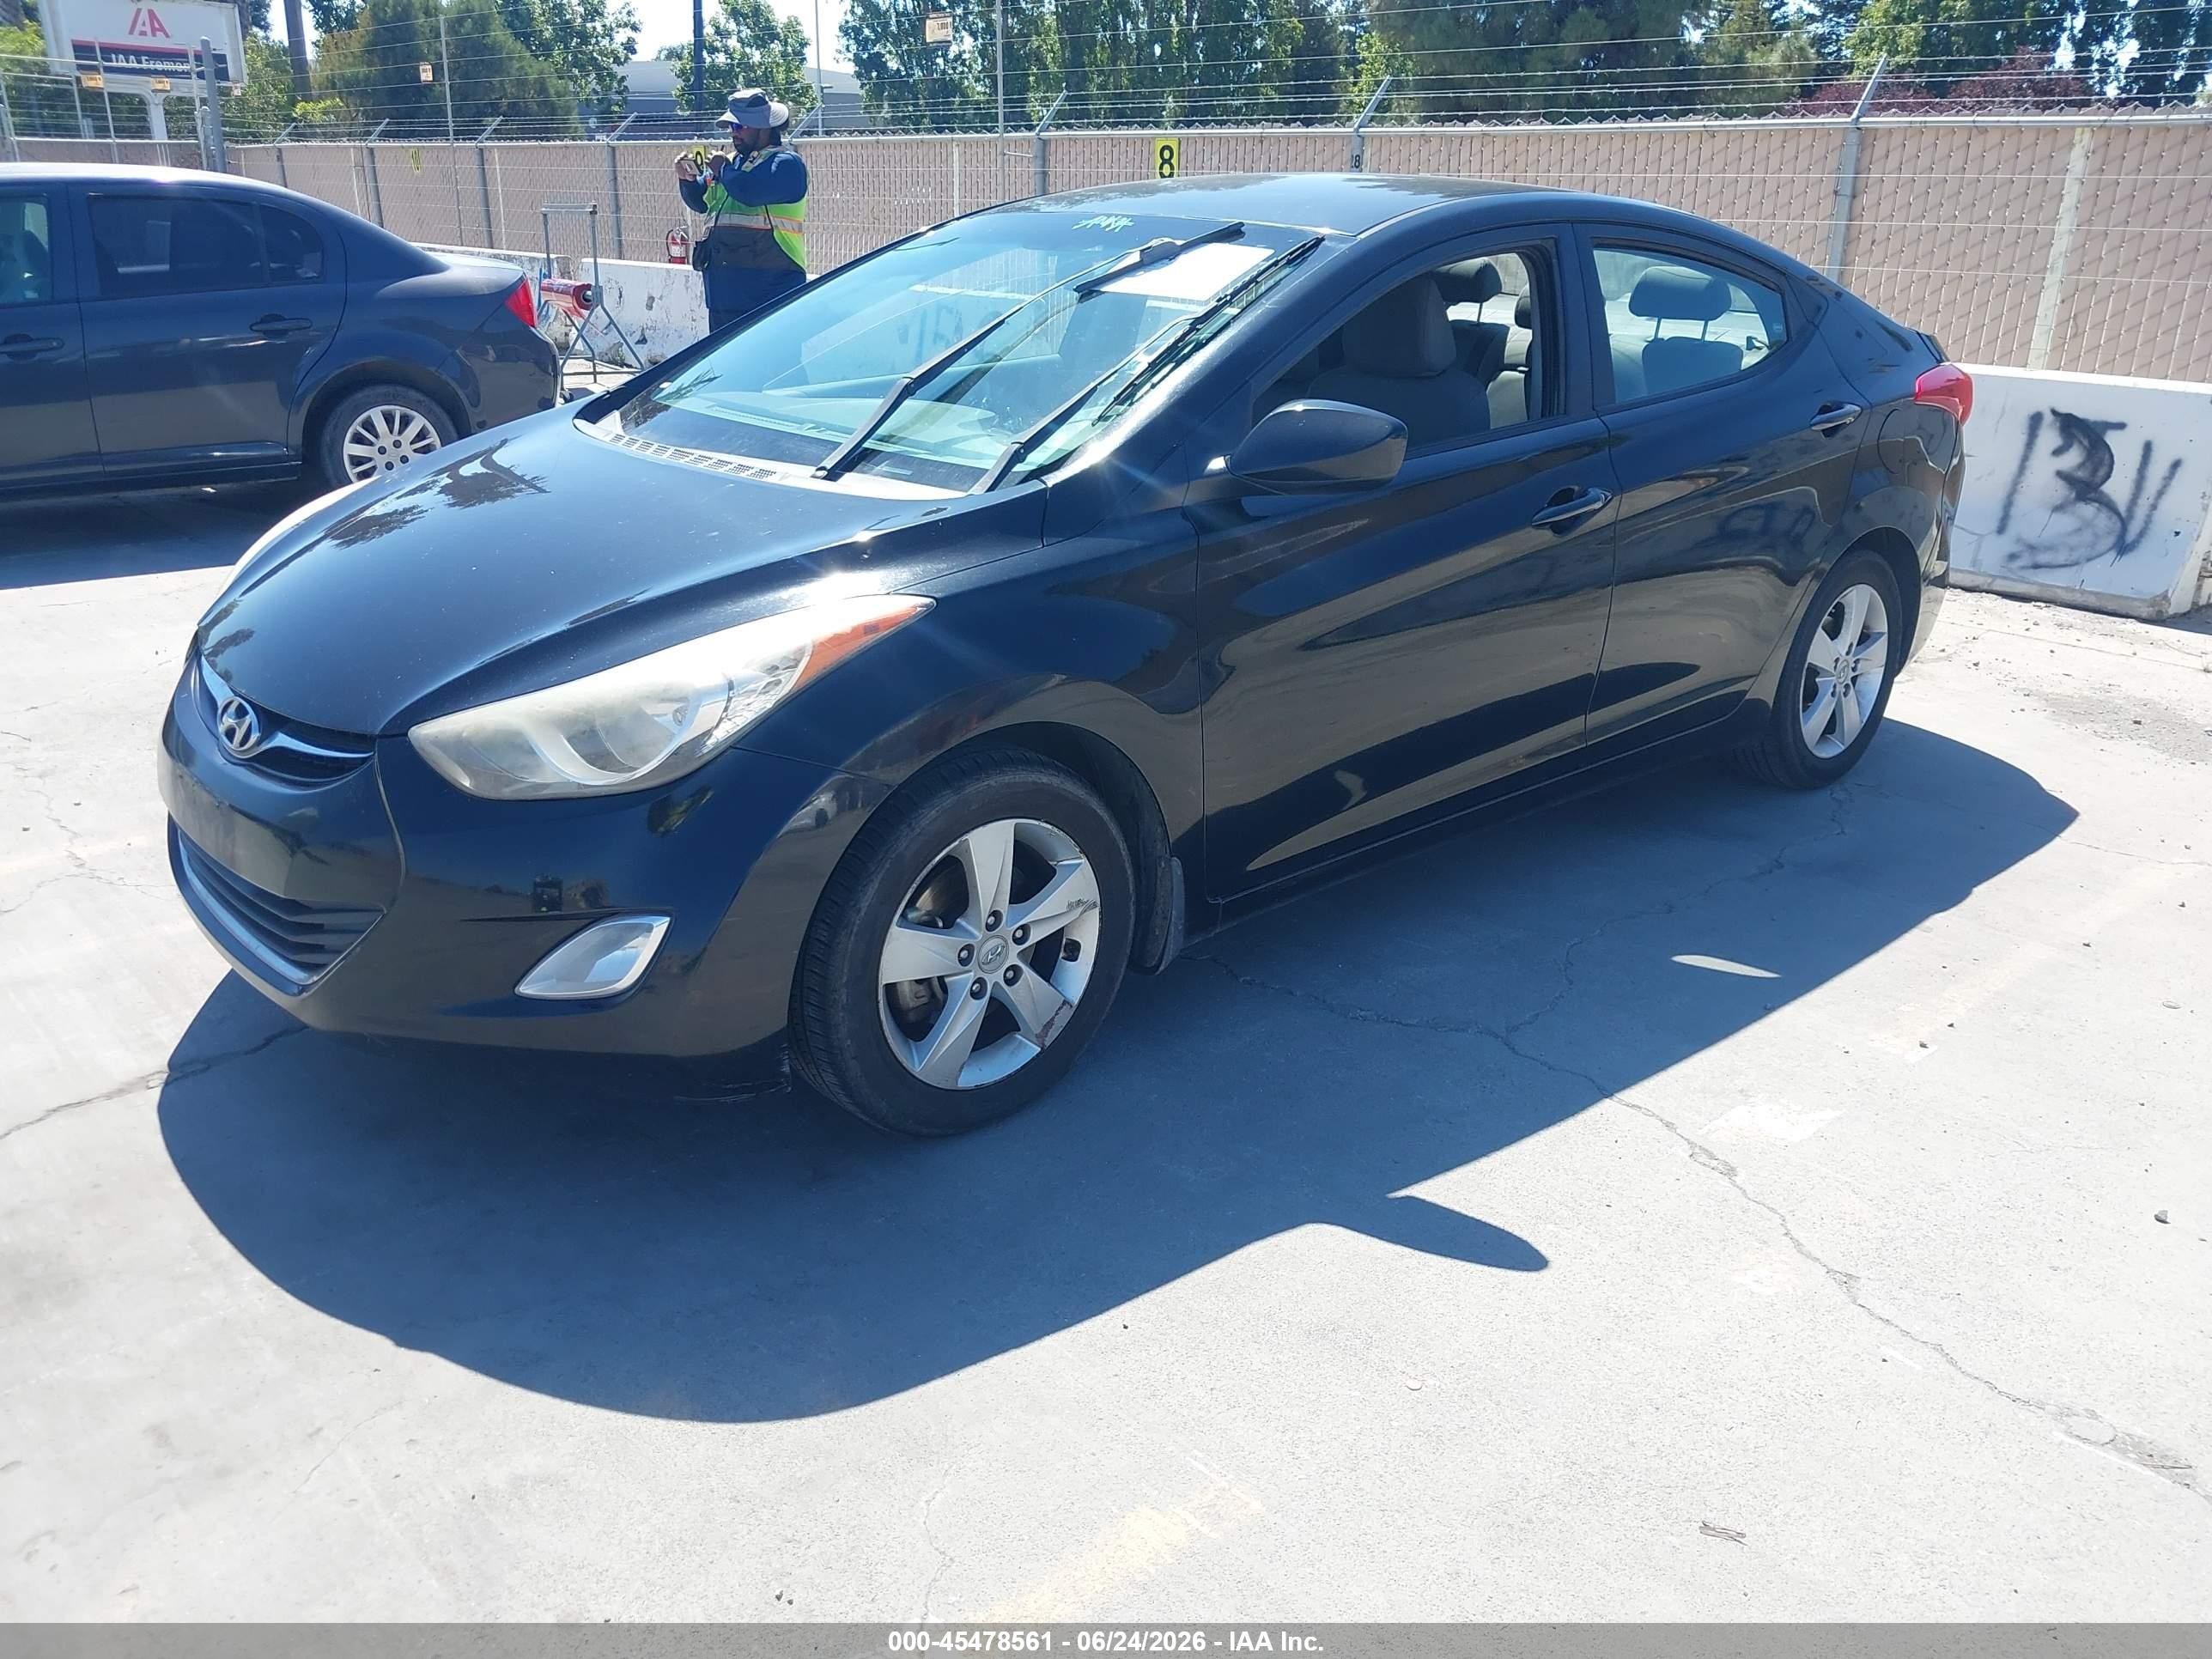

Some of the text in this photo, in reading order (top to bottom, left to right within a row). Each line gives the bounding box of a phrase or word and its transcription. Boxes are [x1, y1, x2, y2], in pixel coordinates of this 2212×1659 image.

[111, 53, 191, 72] IAA Fremon
[1158, 144, 1176, 179] 8
